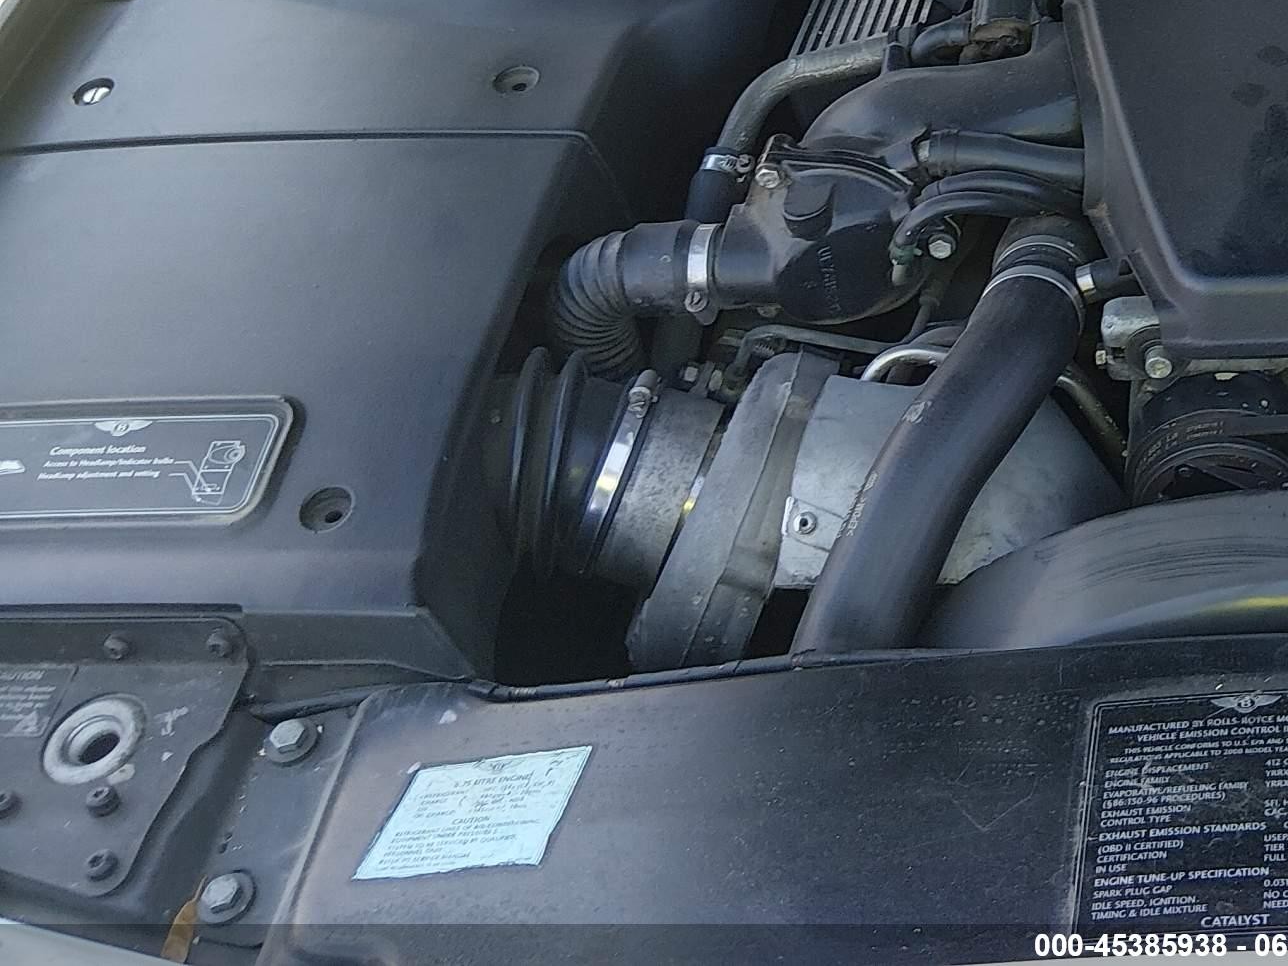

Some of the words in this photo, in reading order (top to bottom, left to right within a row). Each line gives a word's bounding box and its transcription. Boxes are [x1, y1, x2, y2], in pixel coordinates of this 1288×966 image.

[49, 445, 106, 457] Component
[105, 444, 147, 455] location
[1108, 721, 1190, 734] MANUFACTURED
[1192, 720, 1204, 728] BY
[1137, 732, 1177, 742] VEHICLE
[1179, 728, 1228, 739] EMISSION
[1230, 725, 1281, 736] CONTROL
[1124, 747, 1141, 755] THIS
[1266, 737, 1285, 745] AND
[1164, 750, 1209, 759] APPLICABLE
[1244, 746, 1273, 754] MODEL
[1105, 767, 1139, 778] ENGINE
[1140, 762, 1209, 775] DISPLACEMENT
[1104, 778, 1139, 789] ENGINE
[1141, 775, 1171, 786] FAMILY
[1218, 781, 1248, 792] FAMILY
[1160, 791, 1226, 803] PROCEDURES)
[1100, 807, 1143, 819] EXHAUST
[1145, 804, 1192, 815] EMISSION
[1100, 817, 1146, 828] CONTROL
[1149, 814, 1172, 824] TYPE
[1099, 829, 1147, 842] EXHAUST
[1149, 826, 1200, 837] EMISSION
[1203, 822, 1268, 834] STANDARDS
[1097, 843, 1123, 855] (OBD
[1133, 839, 1184, 851] CERTIFIED)
[1264, 843, 1285, 852] TIER
[1096, 850, 1168, 864] CERTIFICATION
[1263, 853, 1287, 862] FULL
[1095, 865, 1107, 874] IN
[1108, 863, 1128, 873] USE
[1094, 875, 1138, 888] ENGINE
[1138, 871, 1186, 883] TUNE-UP
[1188, 867, 1270, 881] SPECIFICATION
[1092, 888, 1122, 900] SPARK
[1124, 886, 1150, 897] PLUG
[1263, 889, 1280, 899] NO
[1091, 900, 1115, 911] IDLE
[1115, 898, 1147, 909] SPEED,
[1091, 909, 1126, 921] TIMING
[1128, 908, 1138, 917] &
[1139, 906, 1162, 917] IDLE
[1163, 903, 1209, 915] MIXTURE
[1200, 914, 1271, 928] CATALYST
